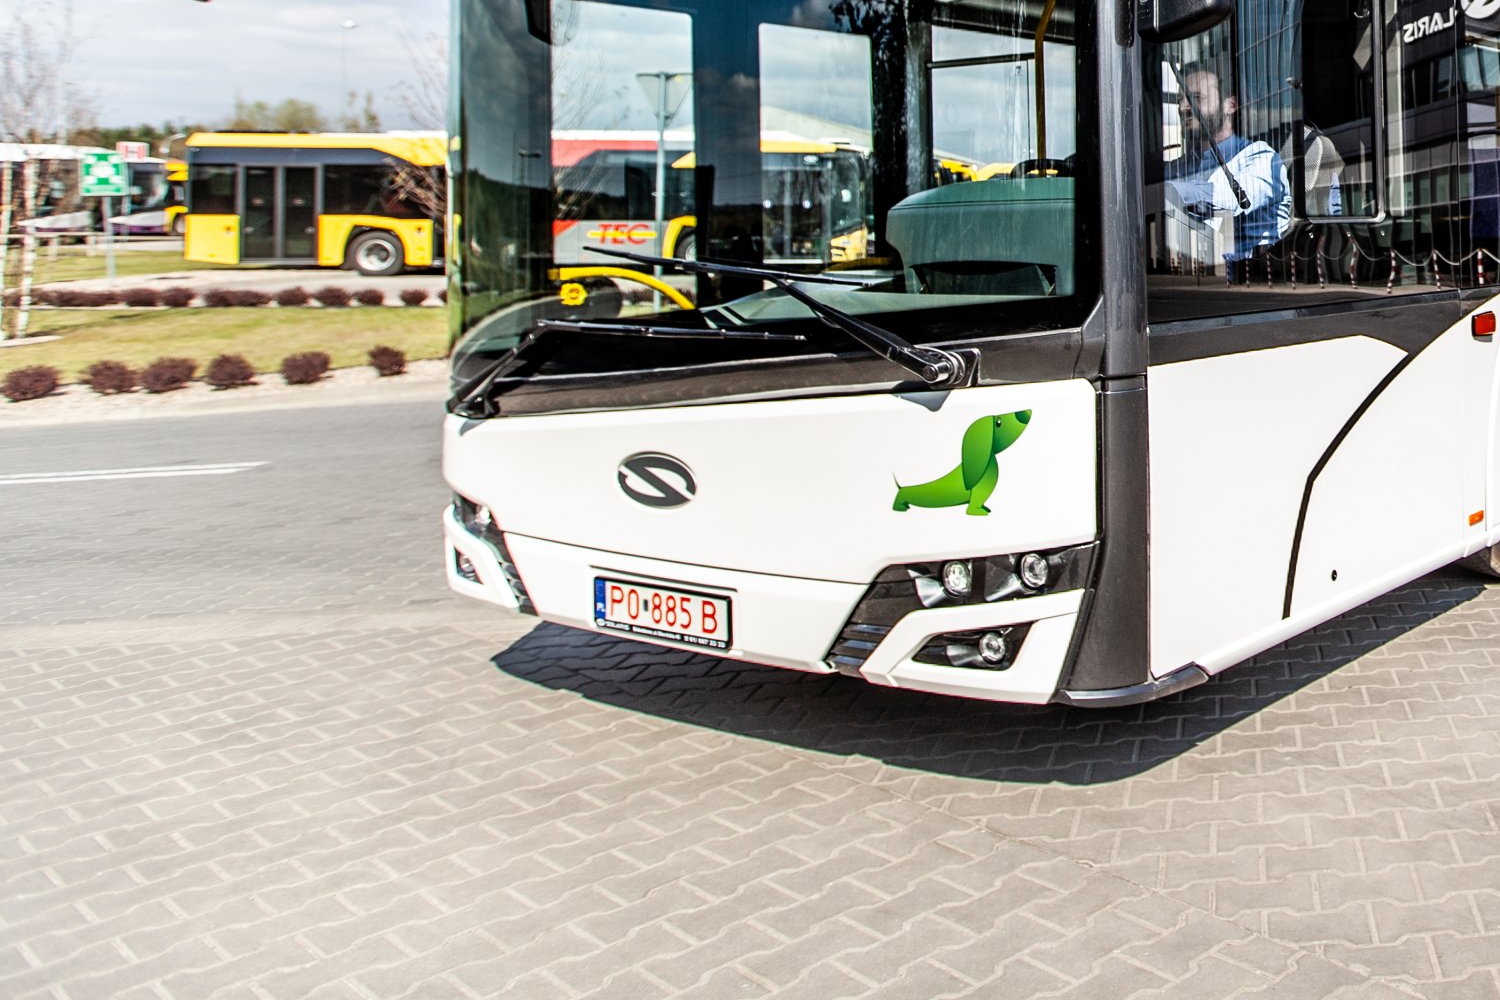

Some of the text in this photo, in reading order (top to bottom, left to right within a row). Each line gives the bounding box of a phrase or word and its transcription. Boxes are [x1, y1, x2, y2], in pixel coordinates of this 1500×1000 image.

[597, 223, 650, 244] TEC
[651, 592, 692, 629] 885
[702, 600, 718, 634] B
